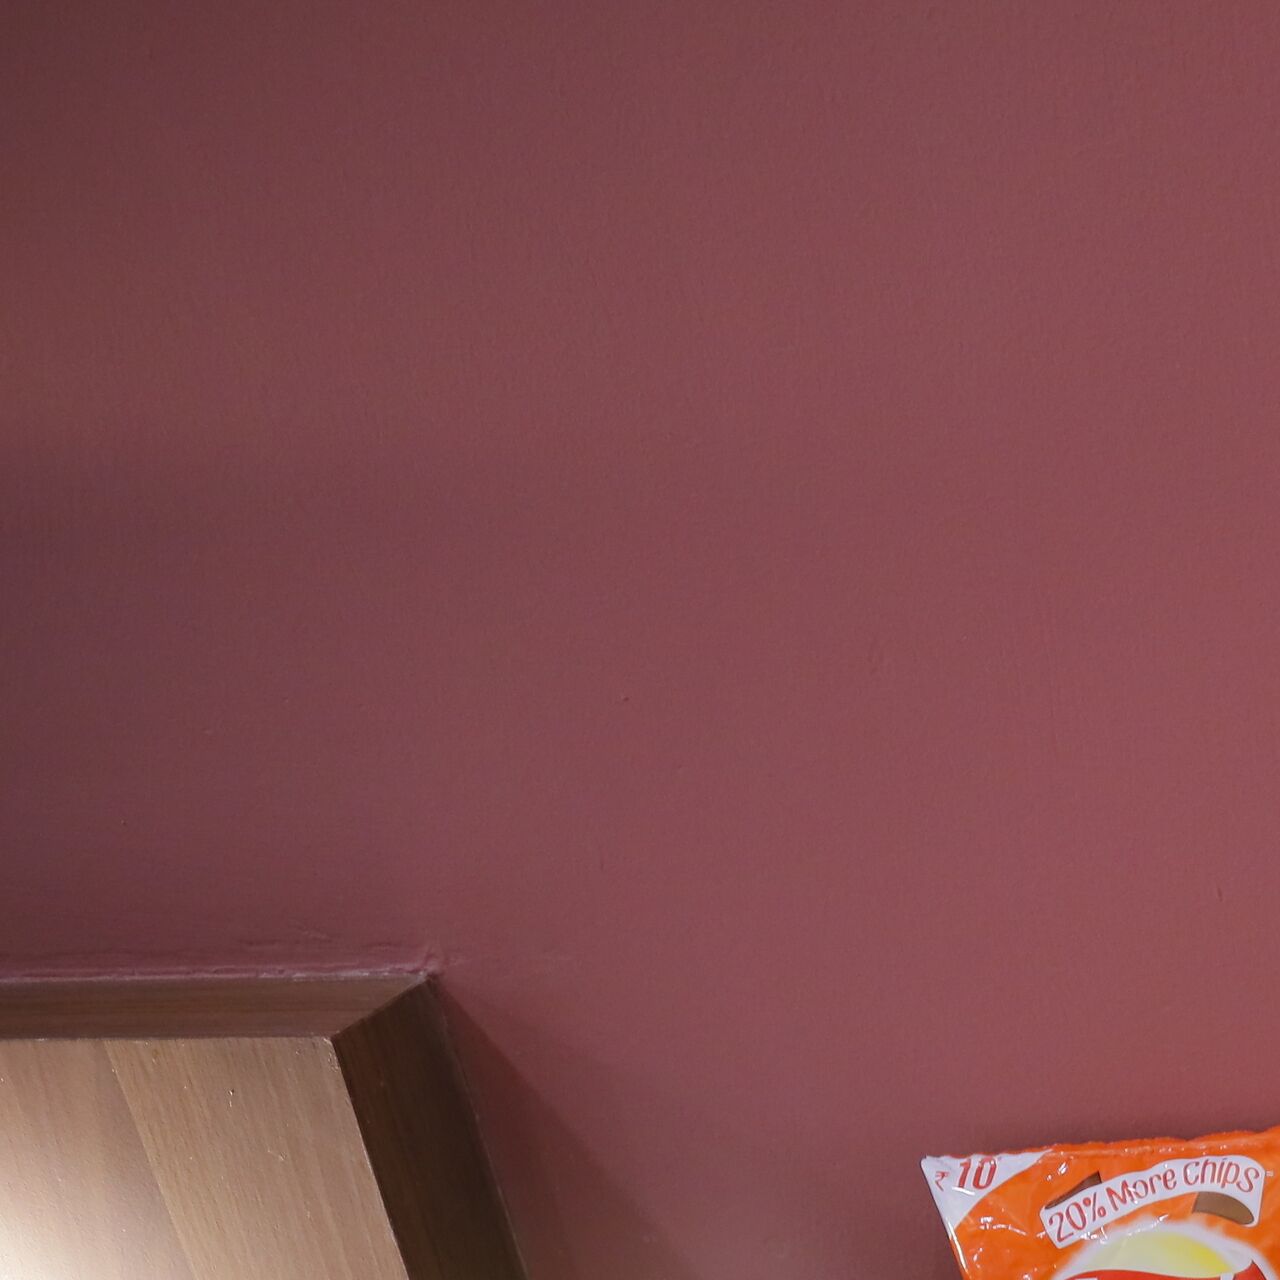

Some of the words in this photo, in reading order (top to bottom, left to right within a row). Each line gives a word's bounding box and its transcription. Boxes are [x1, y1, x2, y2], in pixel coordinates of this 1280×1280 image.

[957, 1155, 998, 1190] 10
[1048, 1191, 1107, 1243] 20%
[1105, 1167, 1177, 1212] More
[1182, 1157, 1260, 1194] Chips
